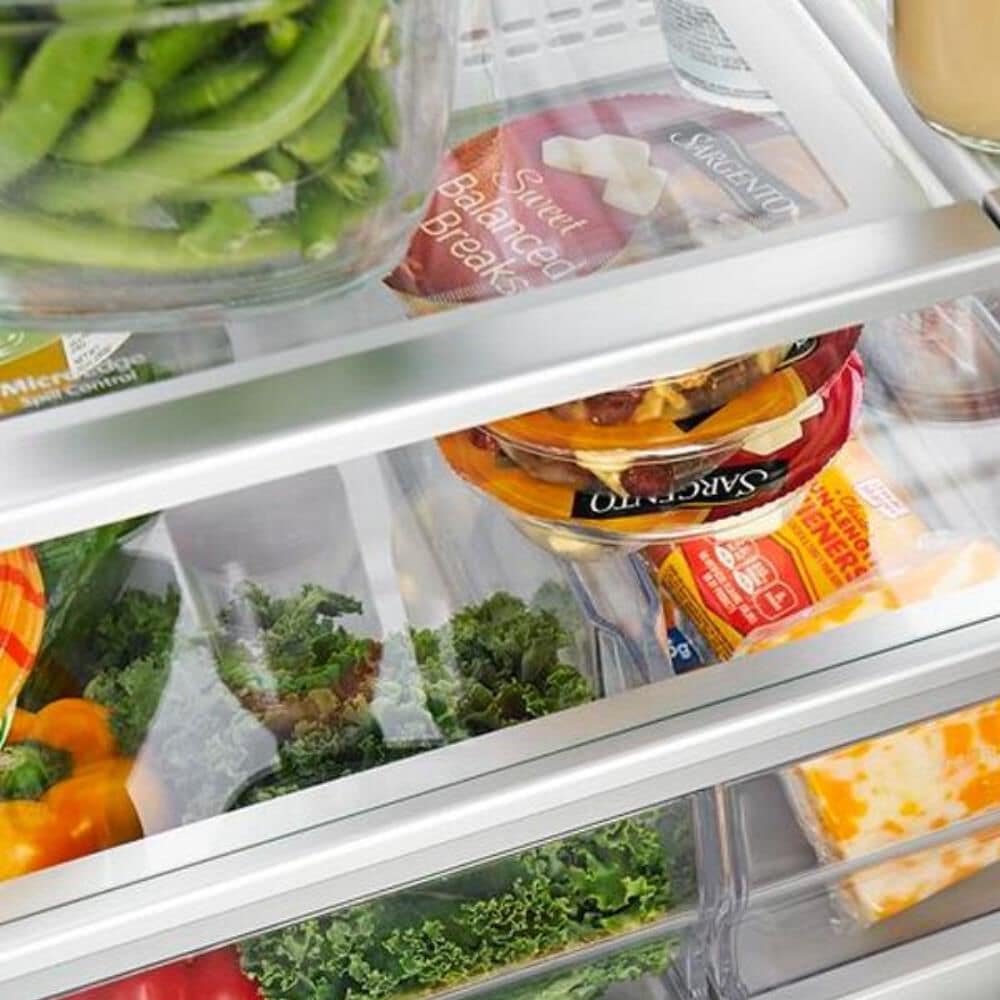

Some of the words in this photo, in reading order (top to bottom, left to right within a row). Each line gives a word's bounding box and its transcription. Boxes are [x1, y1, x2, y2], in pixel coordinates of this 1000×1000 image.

[492, 168, 589, 236] Sweet
[669, 131, 796, 214] SARGENTO
[420, 210, 529, 296] Breaks
[437, 172, 577, 280] Balanced
[67, 371, 138, 396] Control
